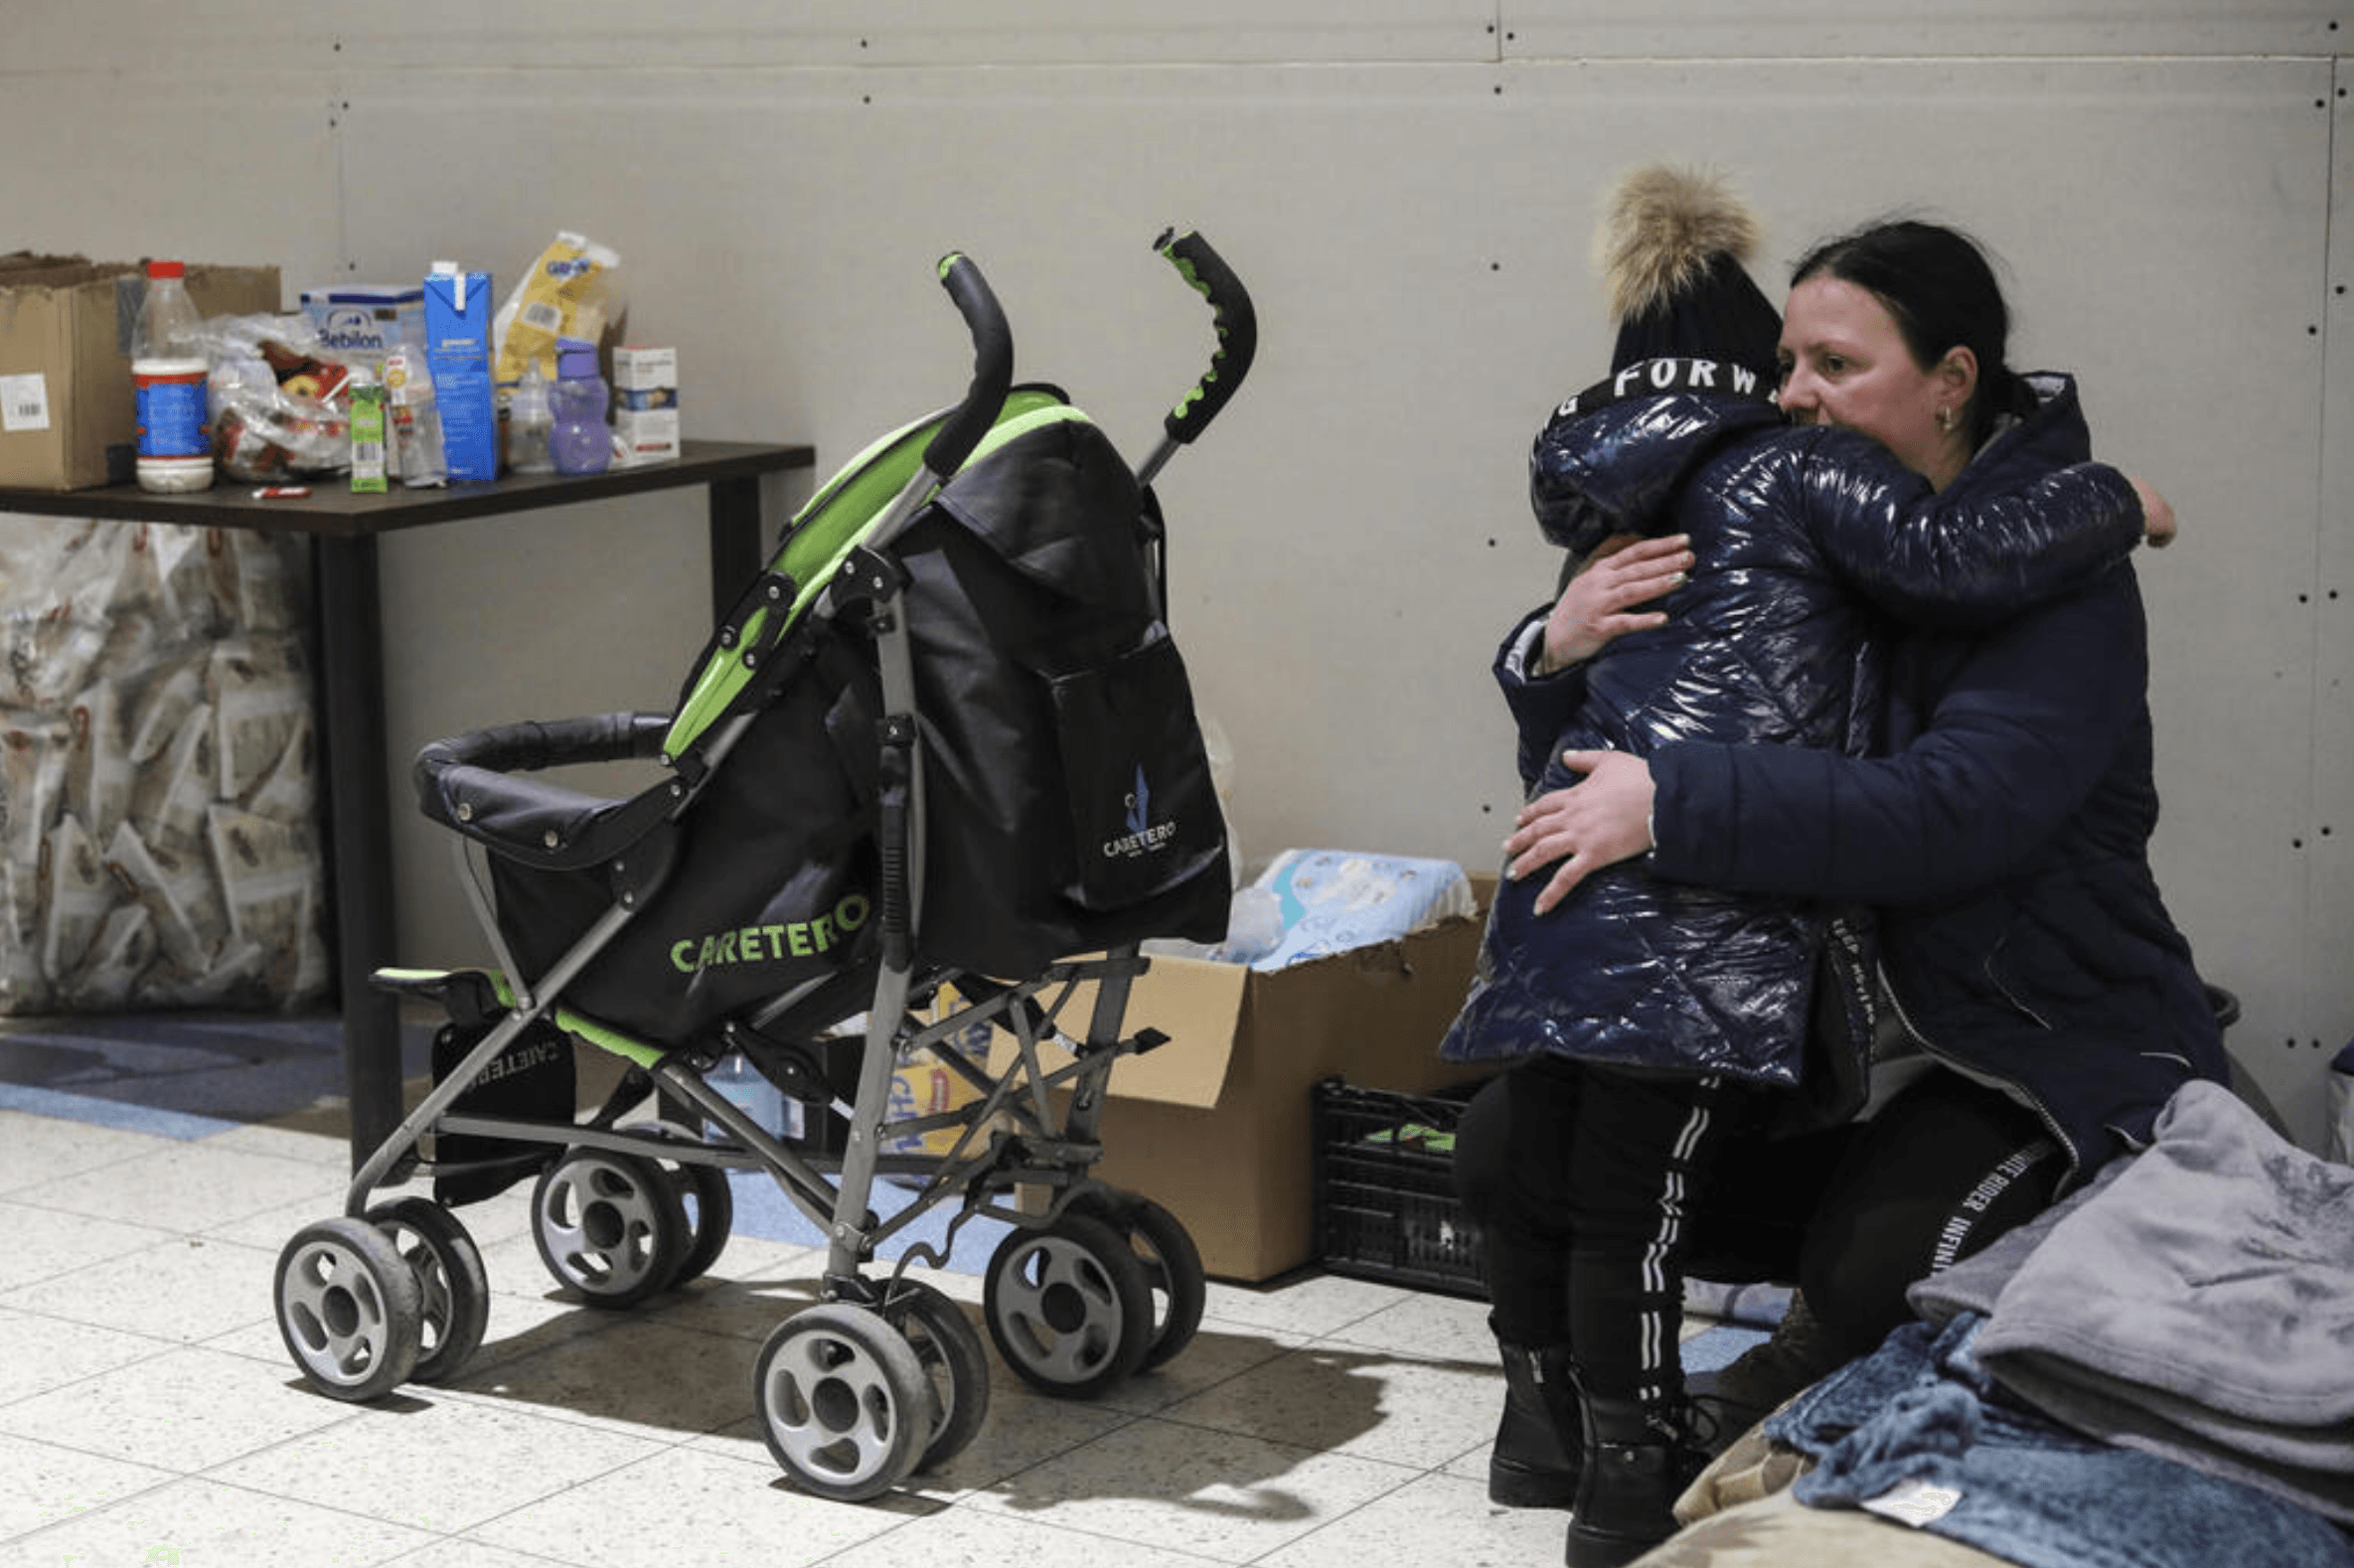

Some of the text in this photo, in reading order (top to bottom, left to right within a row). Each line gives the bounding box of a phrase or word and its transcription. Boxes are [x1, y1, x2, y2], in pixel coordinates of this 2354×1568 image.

[1104, 821, 1177, 858] CARETERO
[670, 895, 870, 973] CARETERO
[1962, 1172, 2010, 1212] RIDER
[1930, 1215, 1972, 1277] INFINI
